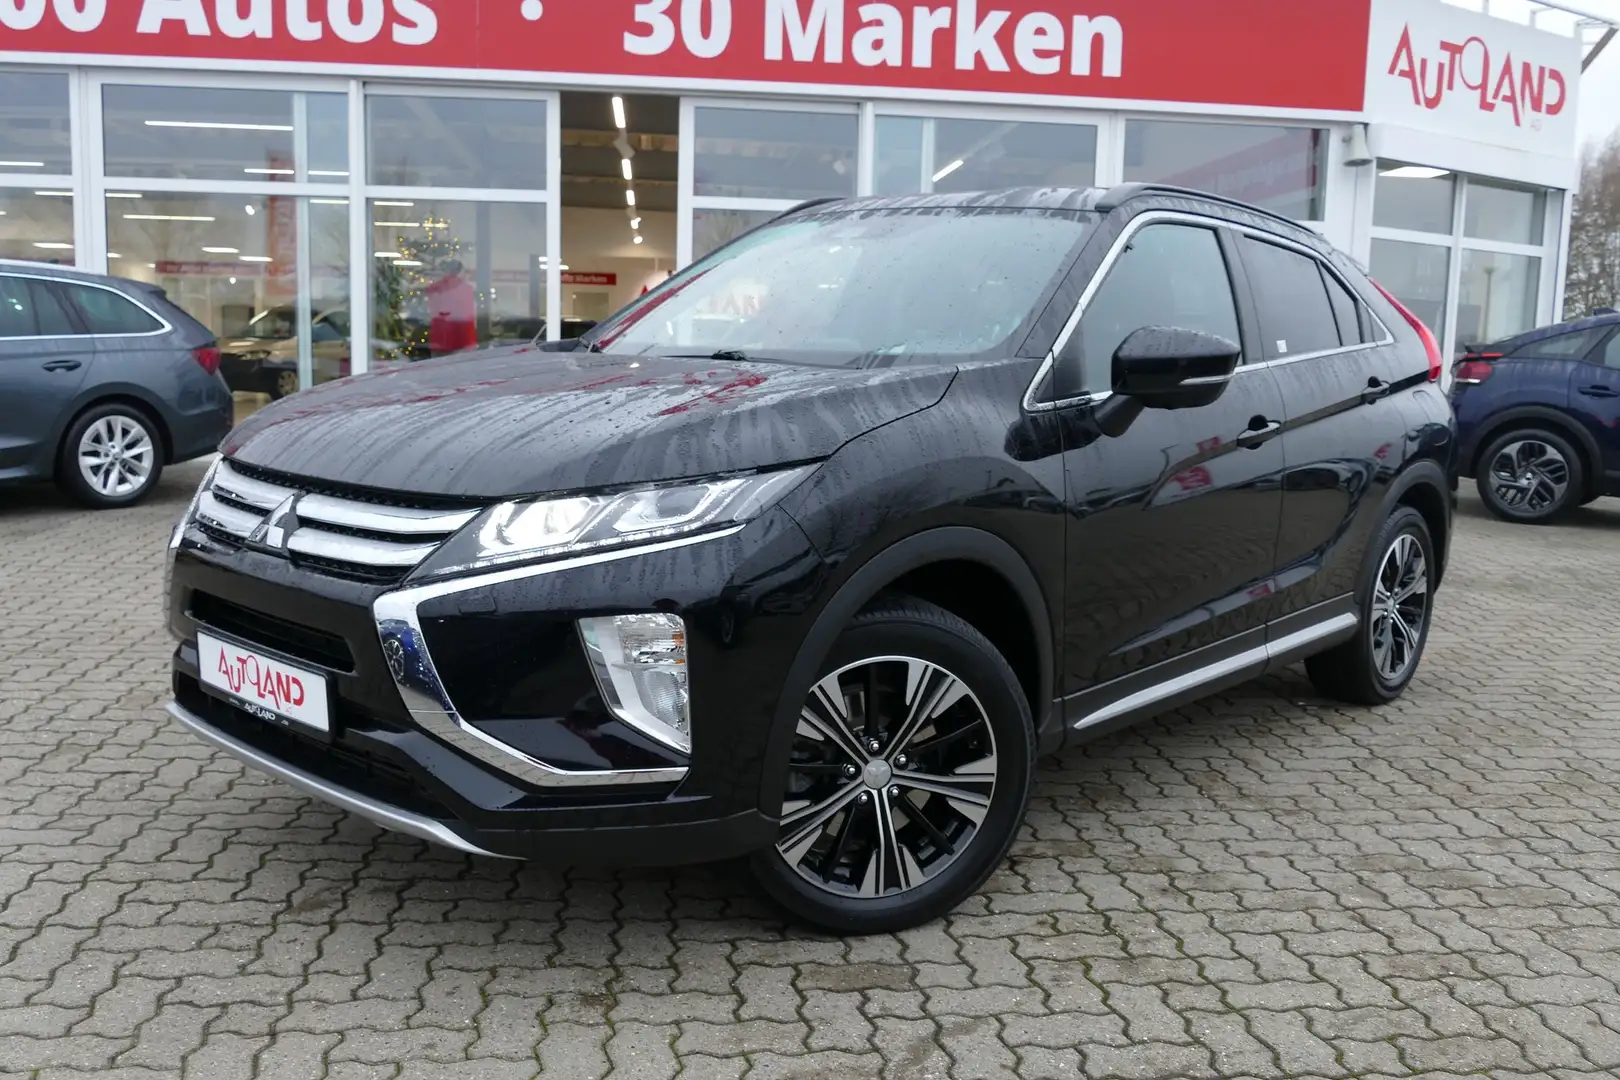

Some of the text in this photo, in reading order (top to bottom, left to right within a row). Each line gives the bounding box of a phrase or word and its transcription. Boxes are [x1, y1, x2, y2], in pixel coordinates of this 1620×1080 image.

[623, 0, 732, 58] 30
[764, 0, 1123, 77] Marken
[1388, 22, 1566, 127] AUTOLAND
[218, 645, 305, 710] AUTOLAND
